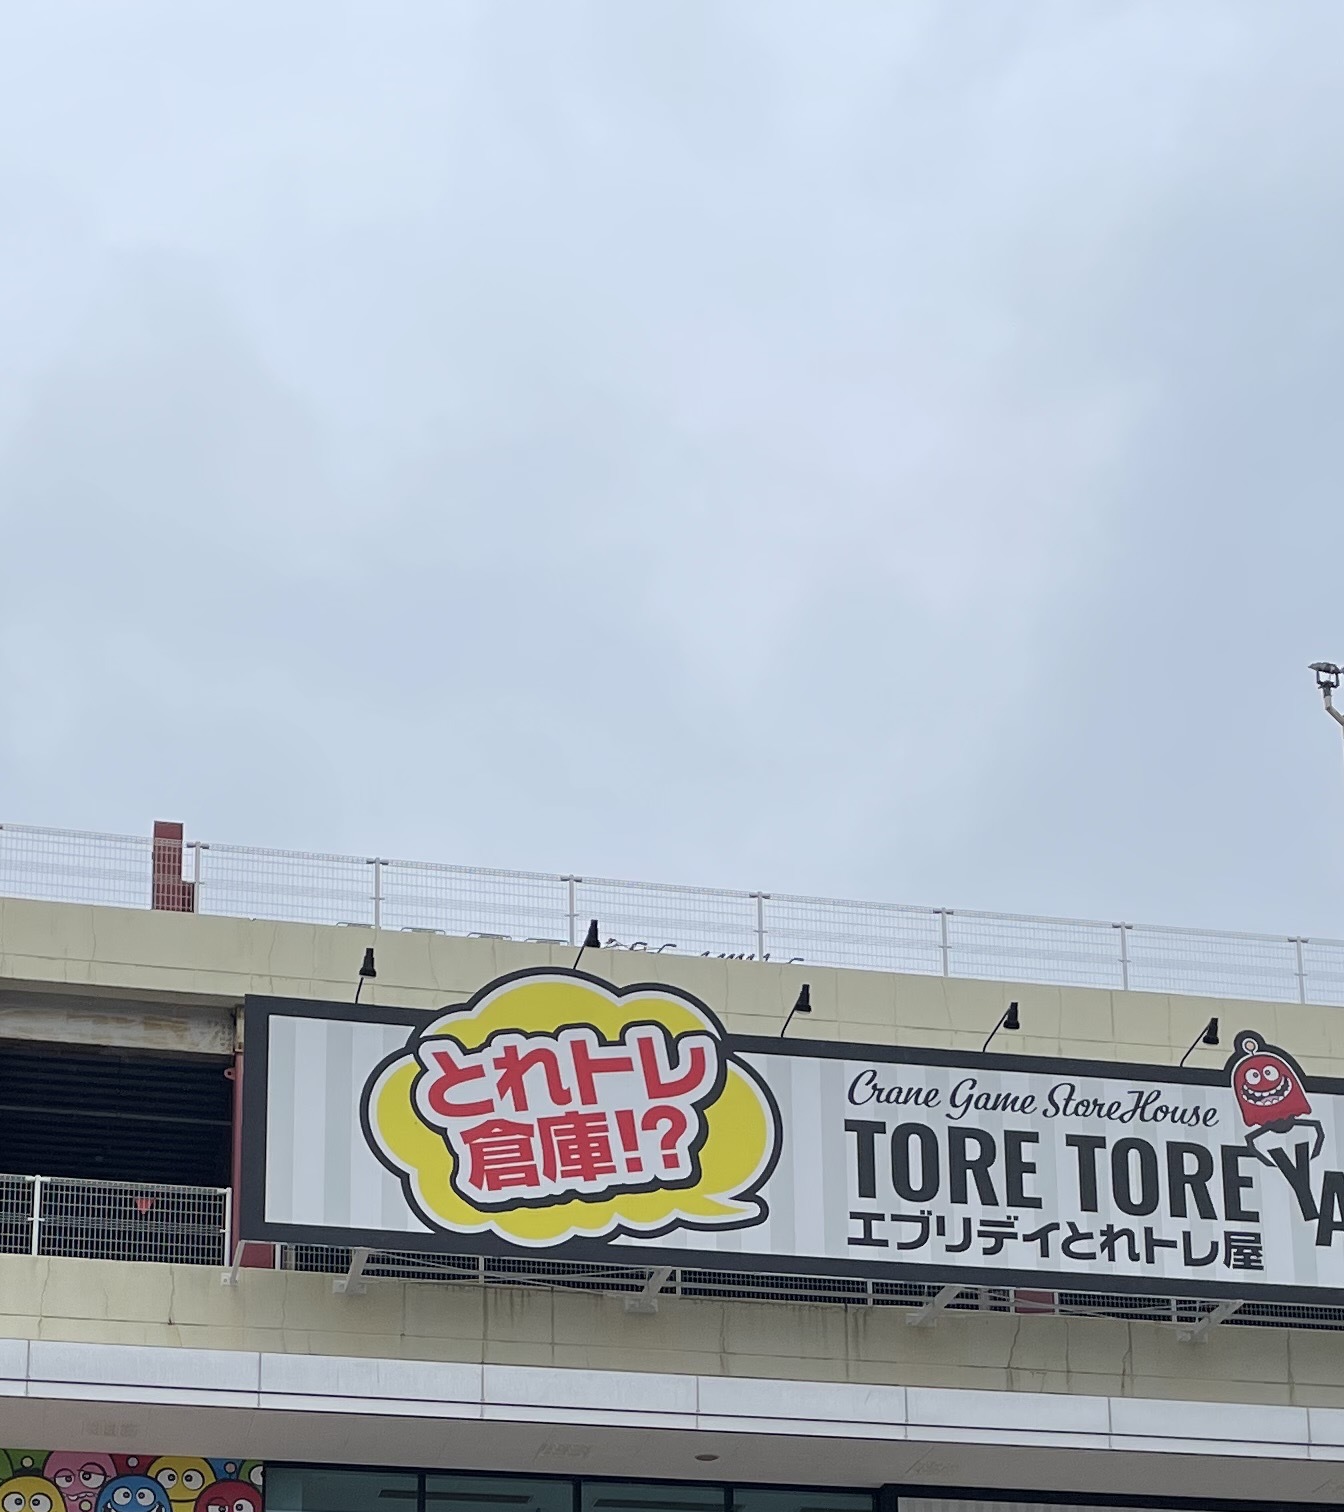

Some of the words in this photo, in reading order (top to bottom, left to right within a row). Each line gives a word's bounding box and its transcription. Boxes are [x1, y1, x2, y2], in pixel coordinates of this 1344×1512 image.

[428, 1036, 706, 1117] とれトレ
[847, 1069, 941, 1108] Crane
[945, 1077, 1037, 1121] Game
[460, 1105, 688, 1191] 倉庫!?
[844, 1118, 1043, 1210] TORE
[847, 1209, 1265, 1271] エブリデイとれトレ屋
